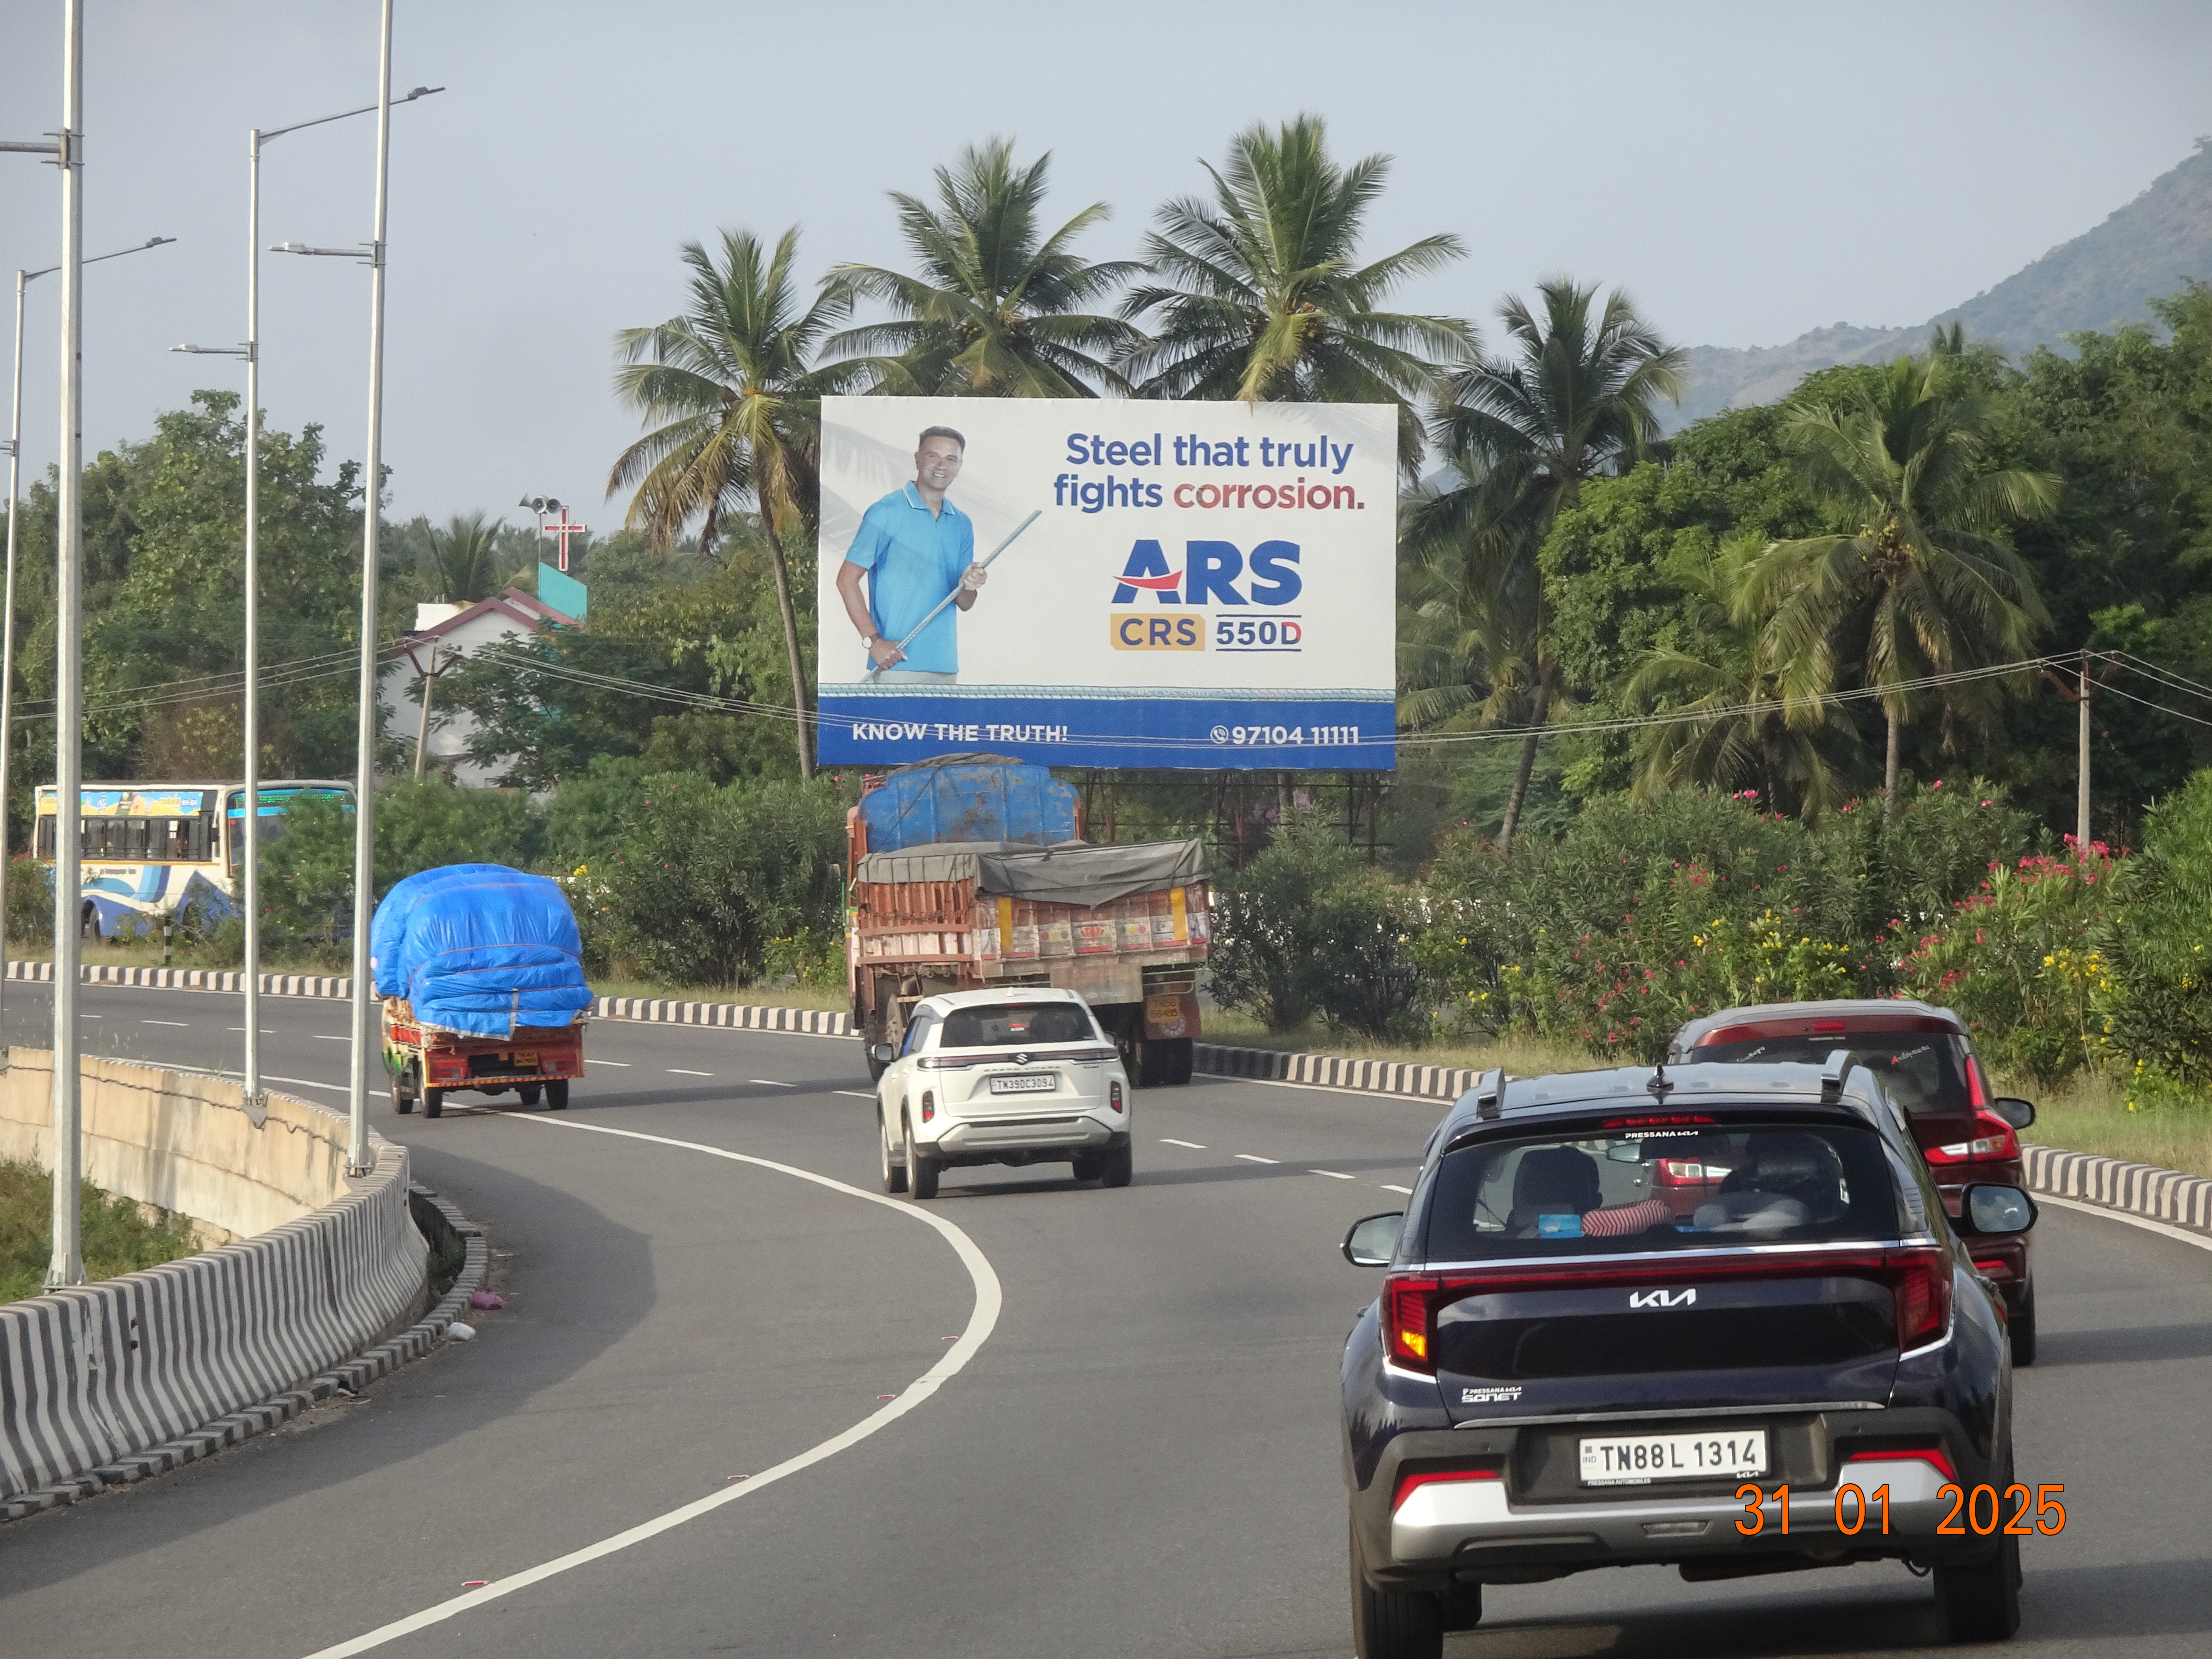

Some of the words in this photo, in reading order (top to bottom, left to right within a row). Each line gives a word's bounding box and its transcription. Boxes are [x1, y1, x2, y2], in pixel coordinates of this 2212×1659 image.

[1066, 433, 1161, 466] Steel
[1173, 434, 1249, 467] that
[1260, 435, 1354, 474] truly
[1054, 473, 1163, 514] fights
[1174, 477, 1364, 510] corrosion.
[1111, 539, 1302, 606] ARS
[1120, 618, 1196, 646] CRS
[1217, 621, 1301, 645] 550D
[852, 723, 927, 740] KNOW
[933, 724, 979, 741] THE
[985, 724, 1068, 742] TRUTH!
[1232, 726, 1304, 745] 97104
[1311, 726, 1359, 745] 11111
[997, 1078, 1054, 1089] TN39DC3094
[1630, 1288, 1696, 1308] KIA
[1462, 1392, 1523, 1403] SONET
[1583, 1456, 1597, 1464] IND
[1694, 1439, 1756, 1467] 1314
